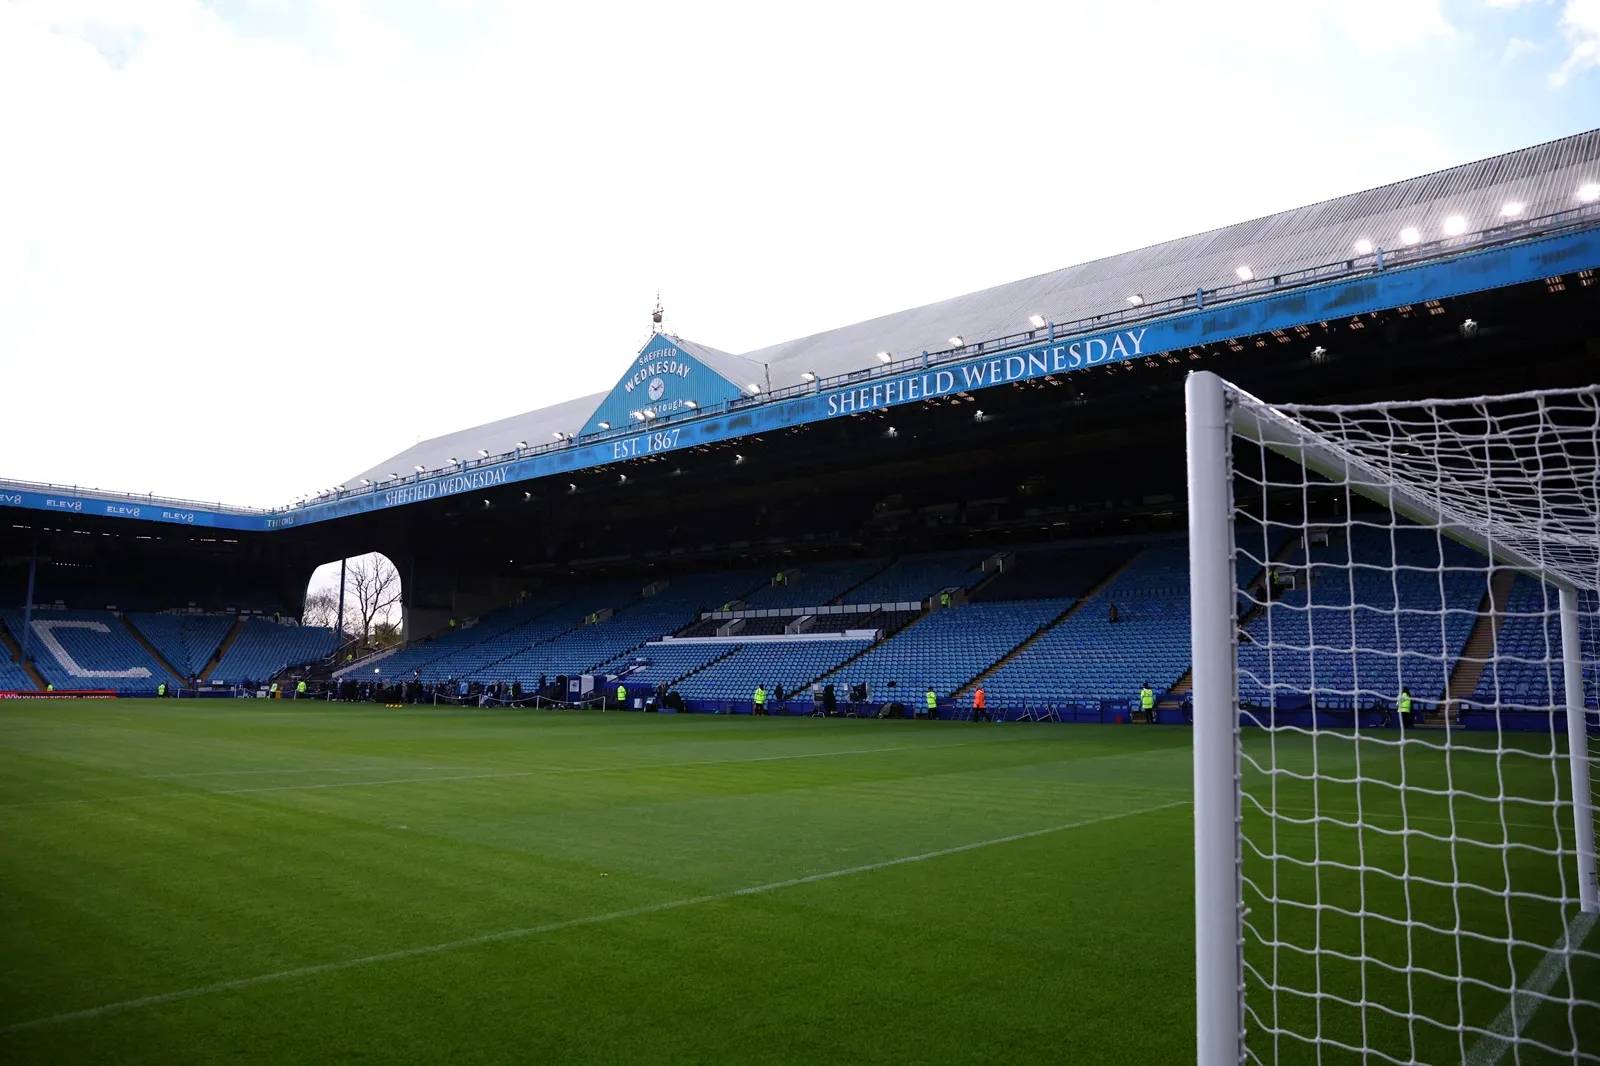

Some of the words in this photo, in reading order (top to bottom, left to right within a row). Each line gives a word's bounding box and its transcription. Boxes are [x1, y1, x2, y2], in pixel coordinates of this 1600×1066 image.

[638, 348, 677, 366] SHEFFIELD
[625, 360, 690, 393] WEDNESDAY
[827, 370, 954, 416] SHEFFIELD
[961, 327, 1149, 388] WEDNESDAY
[613, 437, 641, 459] EST.
[646, 428, 681, 453] 1867
[385, 483, 436, 506] SHEFFIELD
[438, 466, 509, 495] WEDNESDAY
[46, 499, 82, 511] ELEV8
[106, 505, 140, 517] ELEV8
[162, 511, 194, 522] ELEV8
